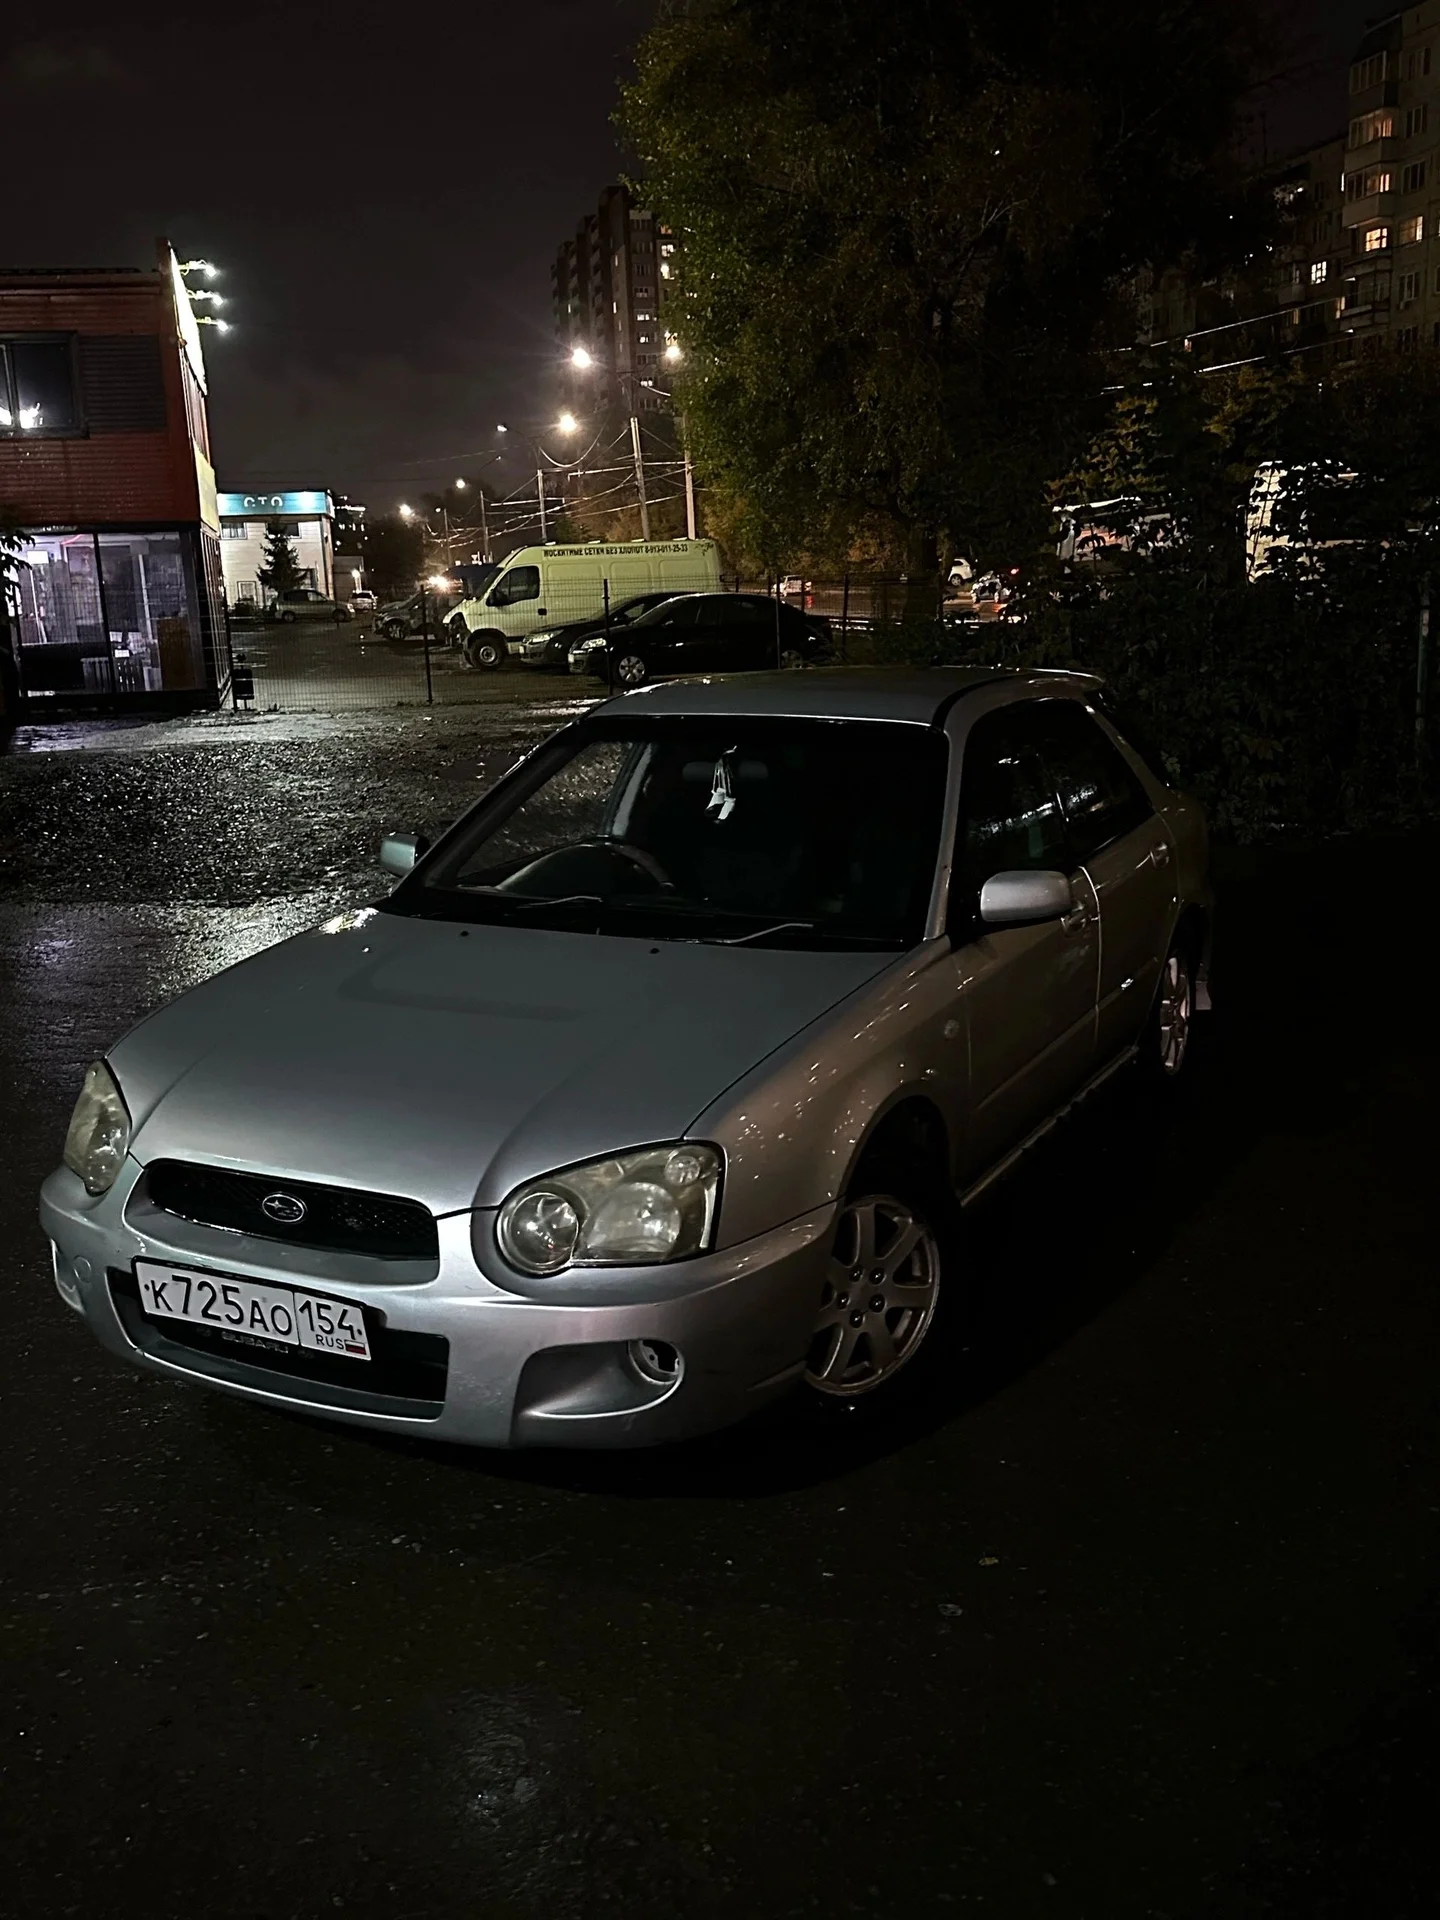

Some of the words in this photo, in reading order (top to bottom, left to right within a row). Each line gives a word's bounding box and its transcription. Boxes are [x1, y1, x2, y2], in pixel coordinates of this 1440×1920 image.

[244, 496, 283, 507] СТО
[584, 547, 604, 556] СЕТКИ
[605, 546, 618, 555] БЕЗ
[298, 1299, 356, 1340] 154
[316, 1334, 344, 1350] RUS
